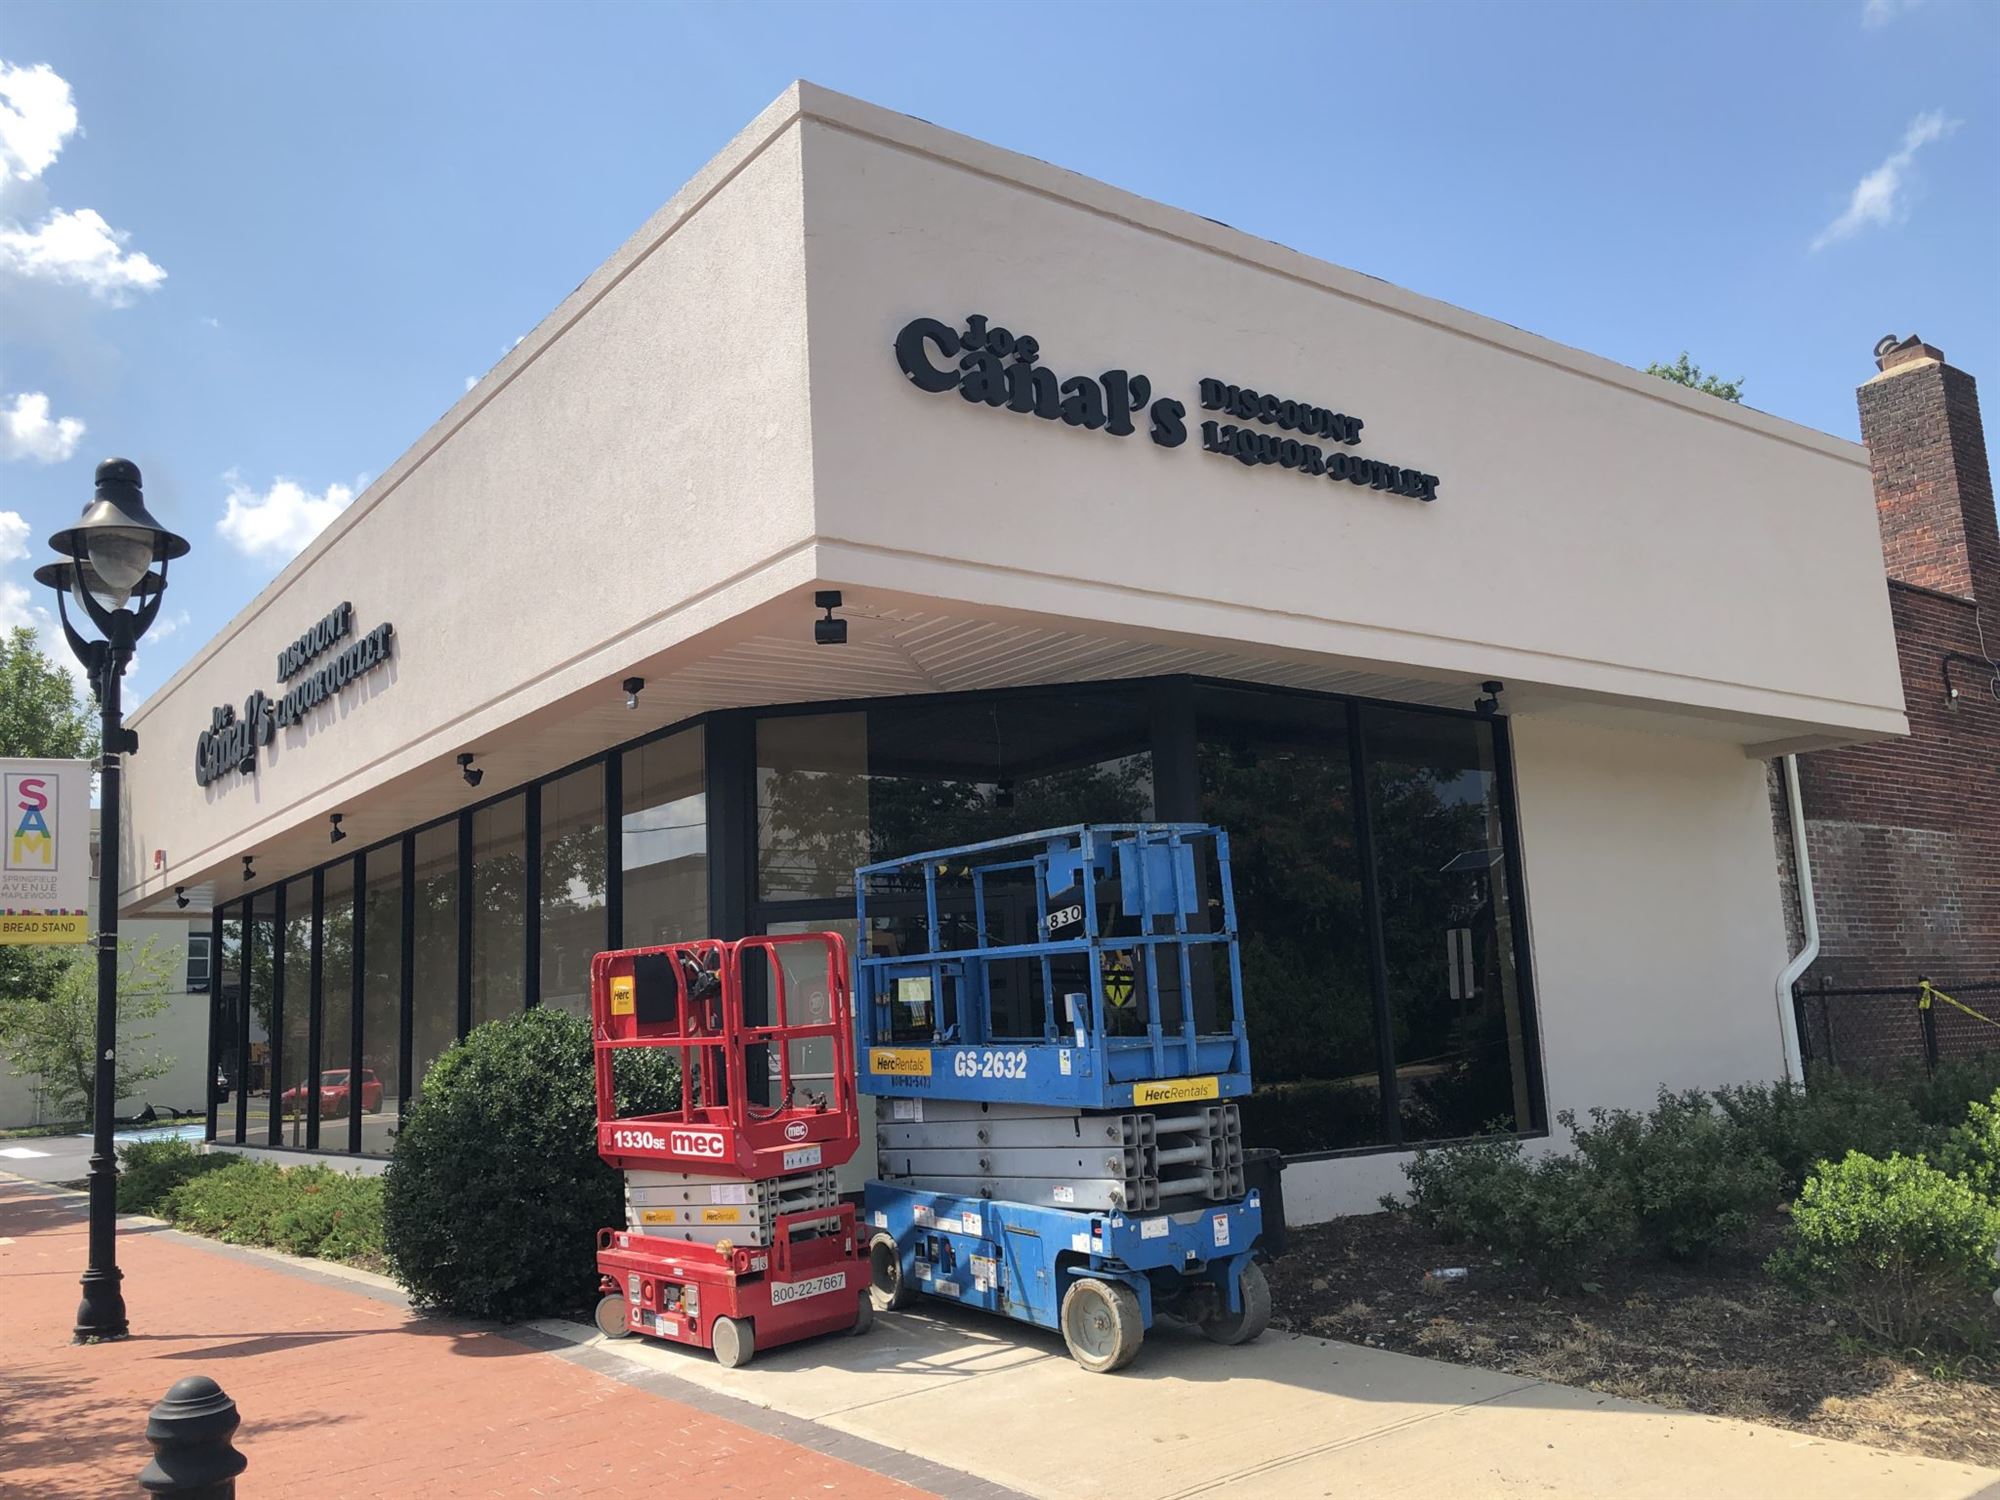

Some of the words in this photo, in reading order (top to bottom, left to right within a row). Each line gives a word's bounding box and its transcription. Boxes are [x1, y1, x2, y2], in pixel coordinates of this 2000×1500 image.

[893, 317, 1187, 448] Canal's
[1198, 377, 1364, 446] DISCOUNT
[1201, 421, 1326, 477] LIQUOR
[1325, 452, 1440, 502] OUTLET
[277, 601, 352, 684] DISCOUNT
[275, 670, 326, 729] LIQUOR
[324, 622, 393, 699] OUTLET
[195, 689, 275, 787] Canal's
[2, 874, 57, 883] SPRINGFIELD
[2, 883, 57, 892] AVENUE
[1, 891, 57, 900] MAPLEWOOD
[3, 922, 39, 933] BREAD
[42, 922, 76, 932] STAND
[1050, 906, 1080, 928] 830
[877, 1057, 924, 1071] HercRentals
[954, 1050, 1027, 1079] GS-2632
[1144, 1083, 1209, 1102] HercRentals
[787, 1125, 805, 1137] mec
[673, 1132, 723, 1156] mec
[772, 1273, 845, 1302] 800-22-7667
